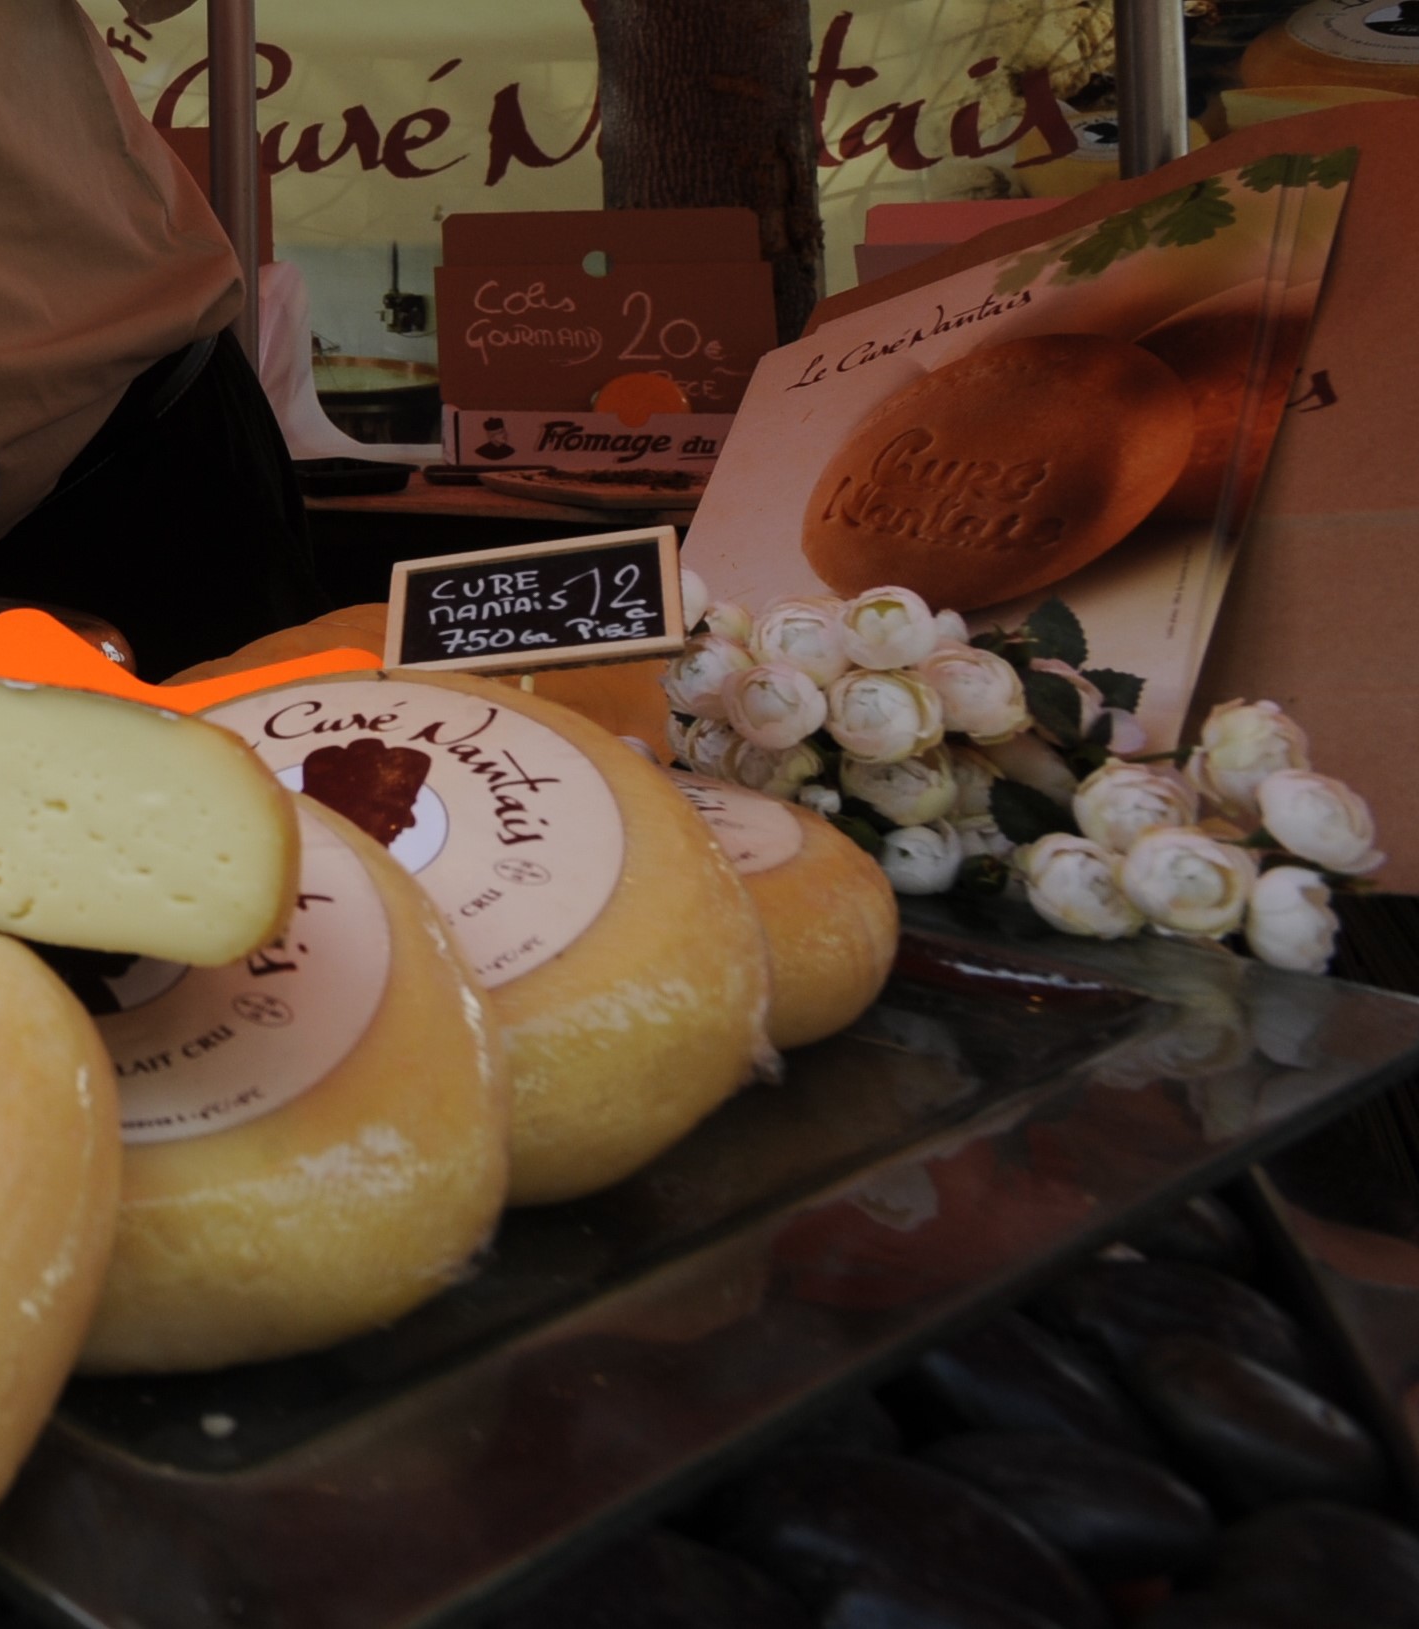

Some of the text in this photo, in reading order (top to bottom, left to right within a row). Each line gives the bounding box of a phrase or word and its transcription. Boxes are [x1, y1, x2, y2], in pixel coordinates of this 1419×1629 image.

[474, 280, 577, 316] Colis
[785, 289, 1032, 392] Le Curé Nantais
[537, 420, 719, 464] Fromage du
[430, 569, 540, 600] CURE
[437, 617, 515, 653] 750
[264, 700, 561, 846] Curé Nantais
[460, 887, 504, 918] CRU
[114, 1023, 236, 1079] LAIT CRU
